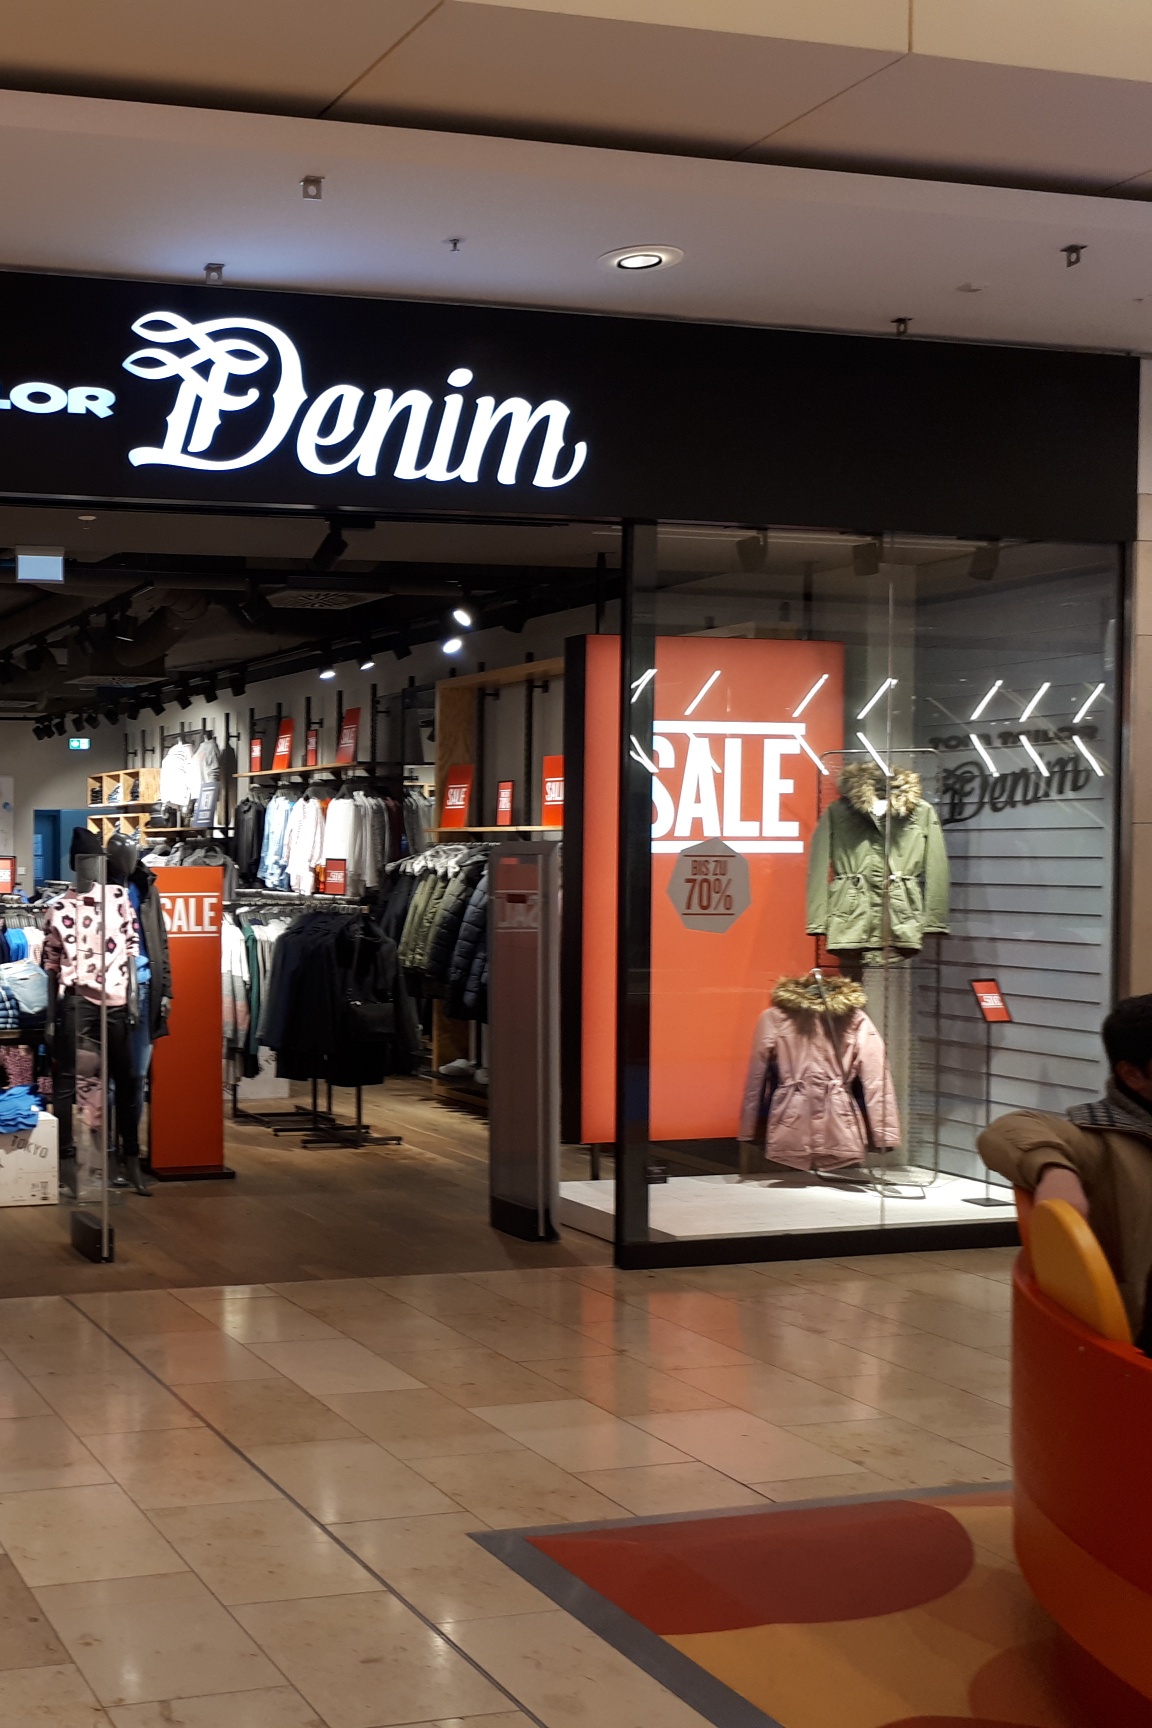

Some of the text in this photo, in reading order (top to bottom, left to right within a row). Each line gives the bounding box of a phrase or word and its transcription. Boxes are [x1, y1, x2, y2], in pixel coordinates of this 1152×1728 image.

[122, 310, 588, 489] Denim
[447, 788, 467, 805] SALE
[651, 734, 801, 838] SALE
[691, 859, 728, 876] BIS ZU
[683, 878, 733, 911] 70%
[160, 897, 218, 932] SALE
[11, 1134, 49, 1158] TOKYO
